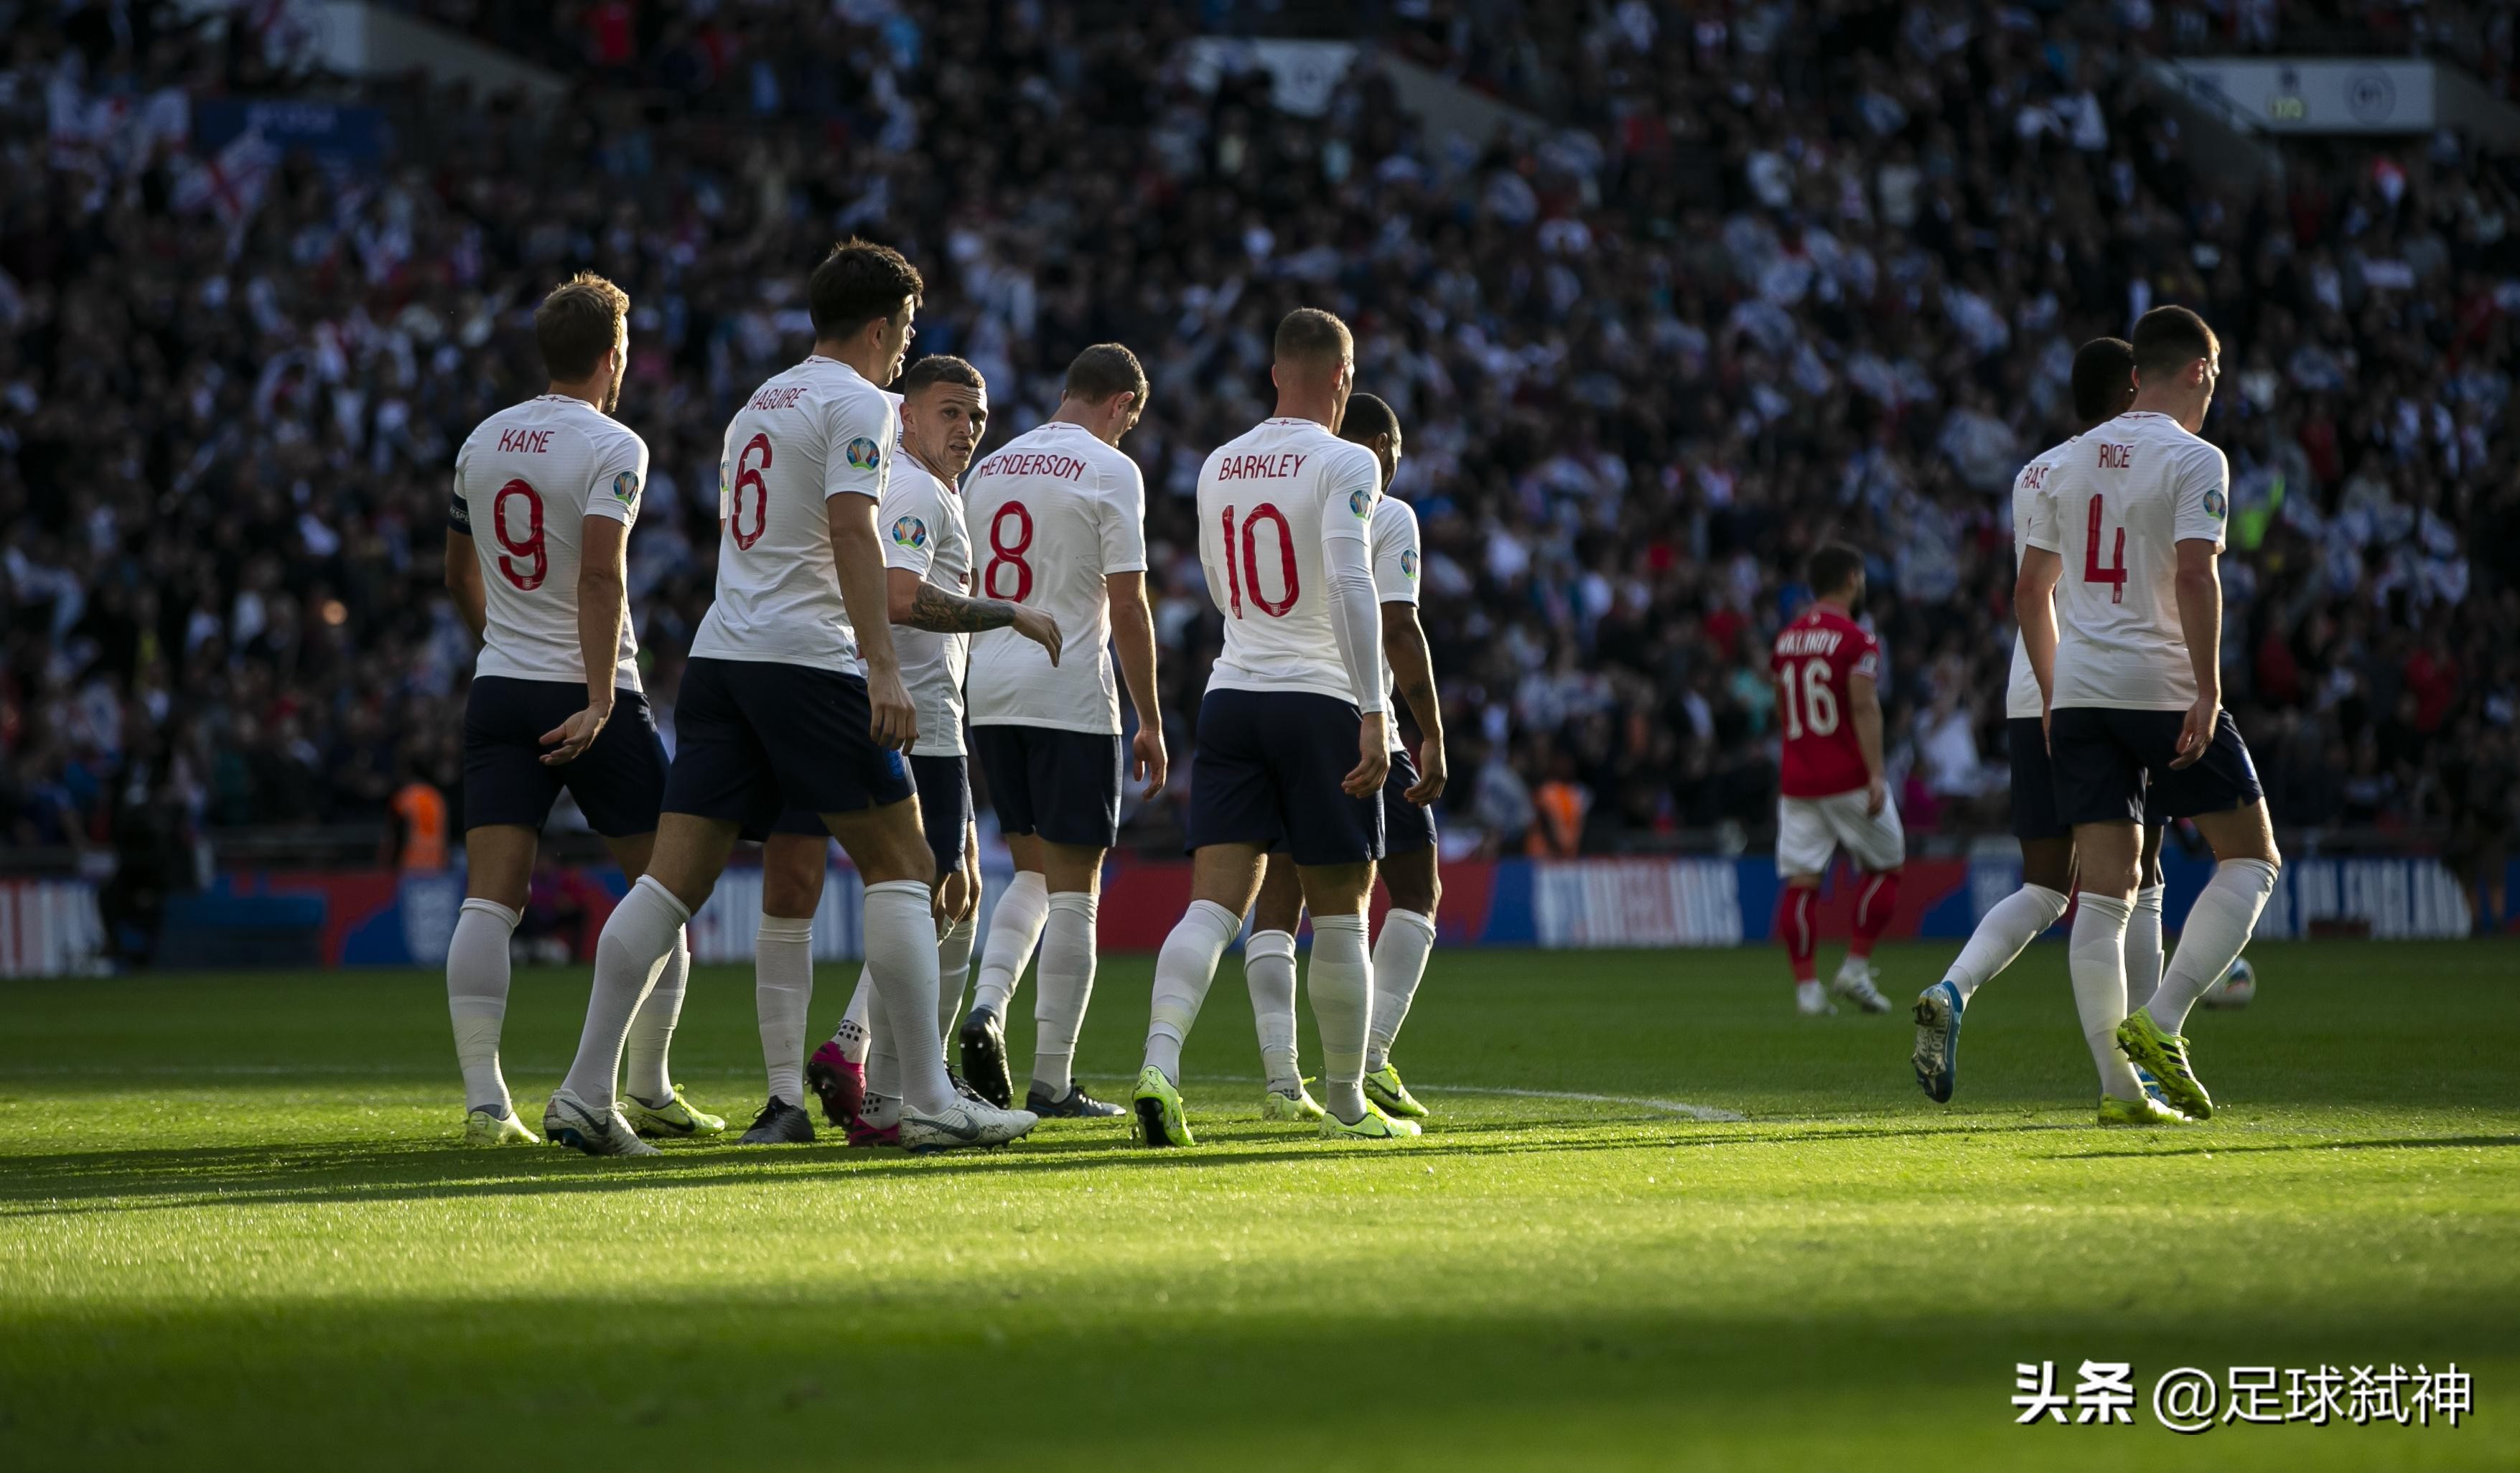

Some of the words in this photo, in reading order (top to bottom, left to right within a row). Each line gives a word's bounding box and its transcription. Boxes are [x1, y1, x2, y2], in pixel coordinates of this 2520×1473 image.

[498, 429, 556, 453] KANE
[744, 388, 808, 413] MAGUIRE
[731, 432, 773, 551] 6
[979, 454, 1087, 482] HENDERSON
[1218, 454, 1307, 480] BARKLEY
[2098, 444, 2134, 469] RICE
[493, 478, 549, 591] 9
[984, 500, 1034, 604] 8
[1222, 502, 1300, 620] 10
[2083, 493, 2128, 604] 4
[1781, 657, 1839, 741] 16
